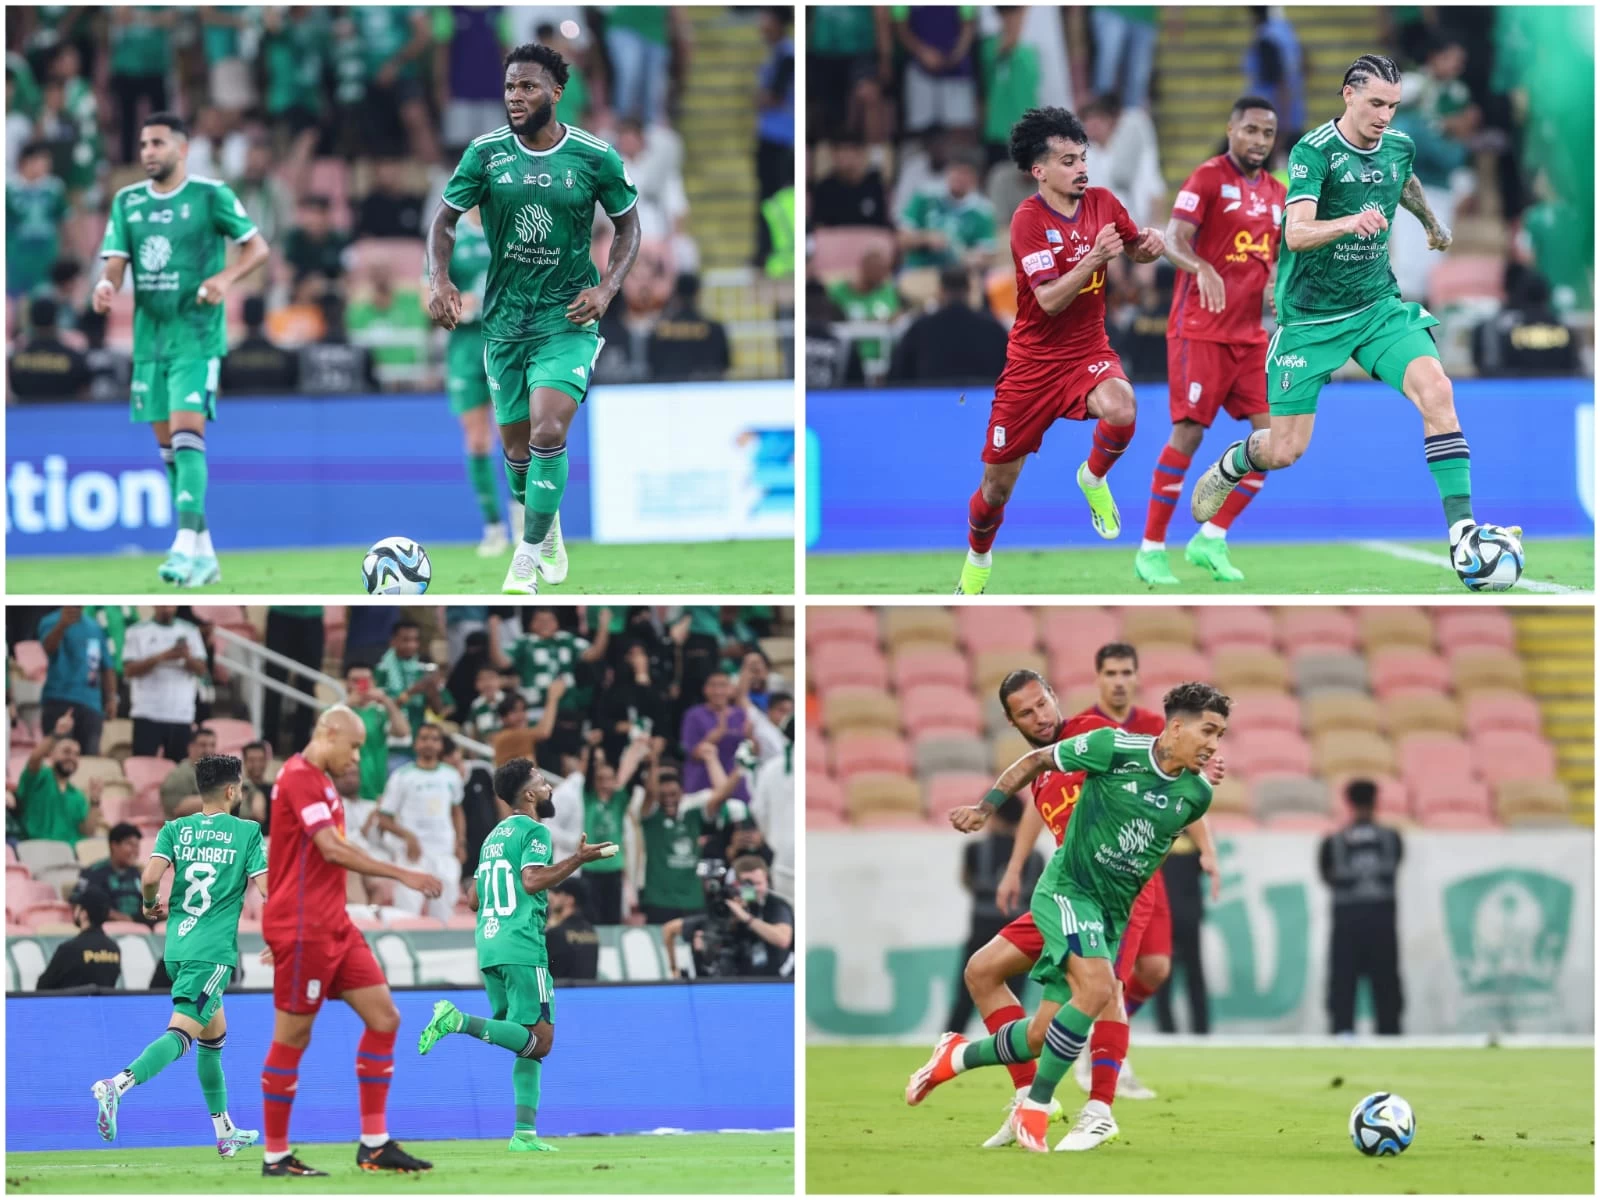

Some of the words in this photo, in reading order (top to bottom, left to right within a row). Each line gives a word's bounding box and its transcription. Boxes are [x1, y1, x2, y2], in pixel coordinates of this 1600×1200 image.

[6, 454, 173, 535] tion
[195, 829, 233, 844] urpay
[182, 862, 217, 917] 8
[479, 859, 517, 917] 20
